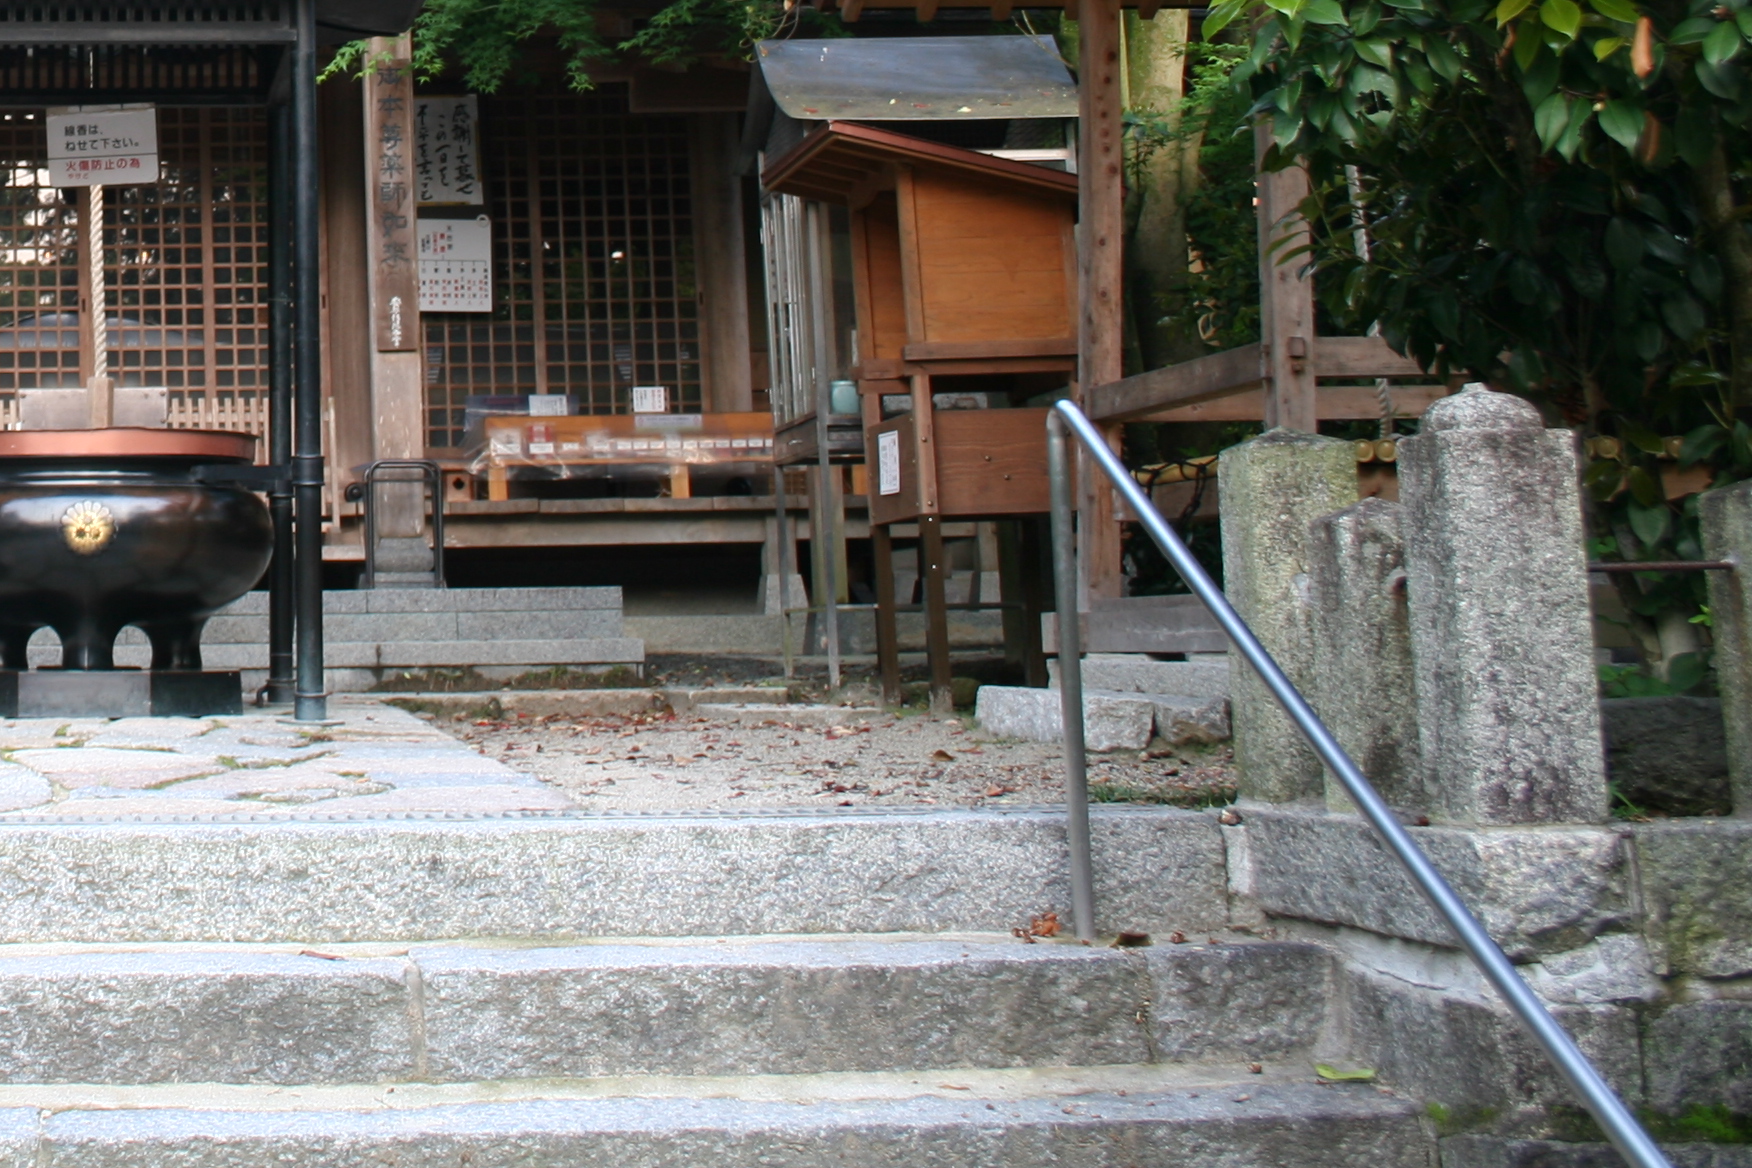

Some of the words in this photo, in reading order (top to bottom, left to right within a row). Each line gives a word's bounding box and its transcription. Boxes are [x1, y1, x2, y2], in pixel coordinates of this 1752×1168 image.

[65, 137, 140, 151] ねせて下さい。
[66, 157, 141, 171] 火傷防止の為
